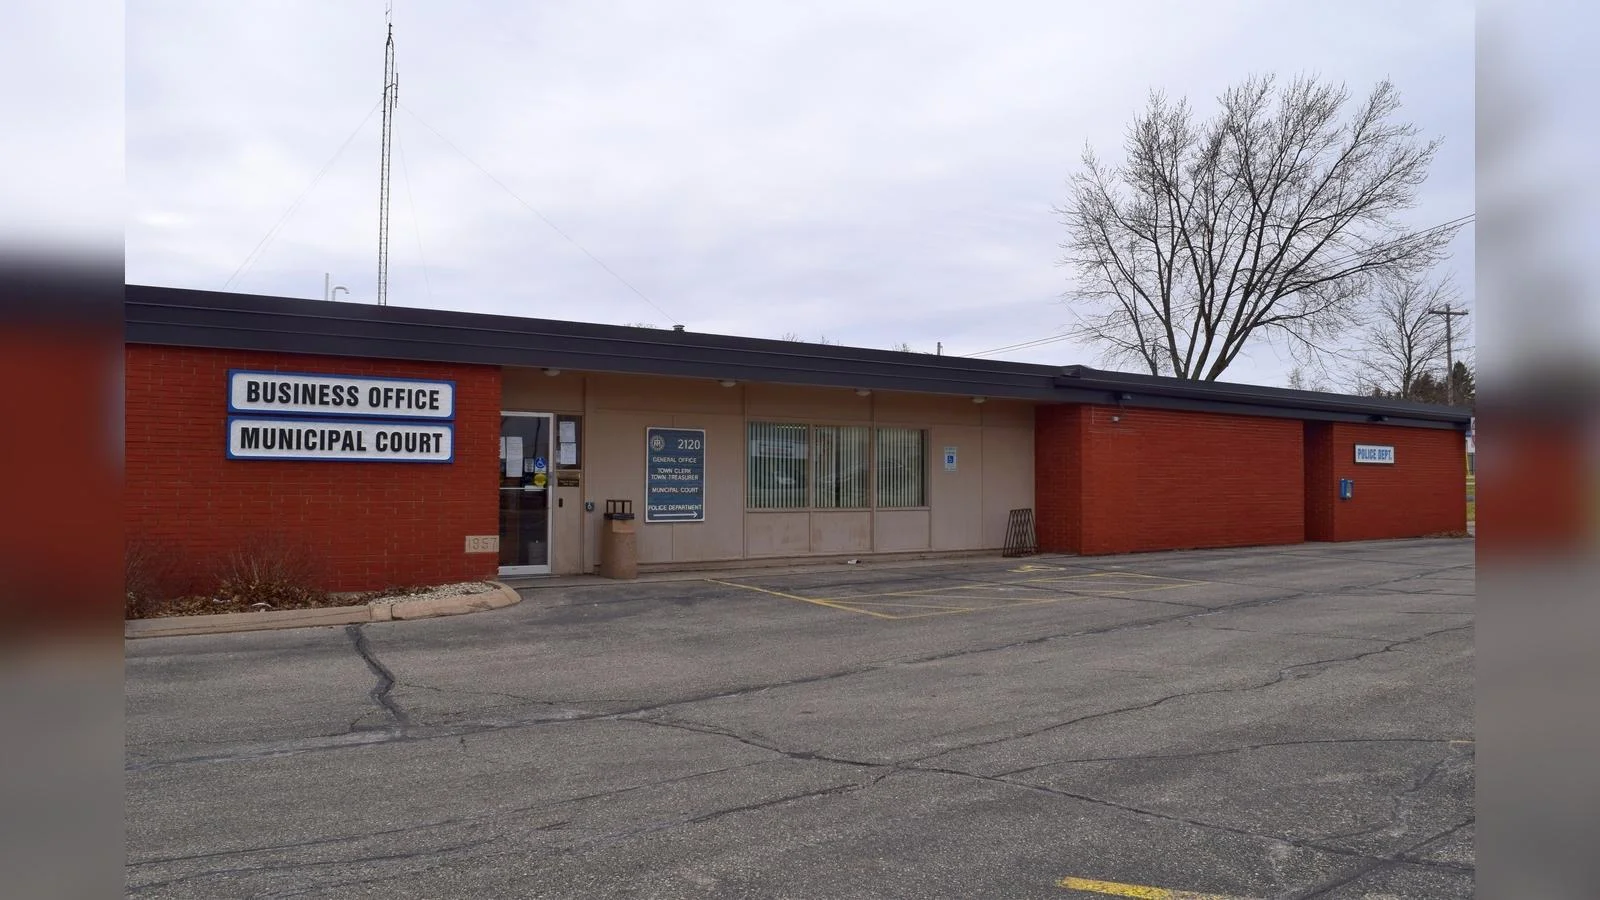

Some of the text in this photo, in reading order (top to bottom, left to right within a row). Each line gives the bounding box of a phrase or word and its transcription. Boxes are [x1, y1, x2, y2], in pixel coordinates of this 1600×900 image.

[247, 381, 440, 410] BUSINESS OFFICE
[240, 427, 443, 453] MUNICIPAL COURT
[678, 439, 700, 450] 2120
[1358, 448, 1376, 460] POLICE
